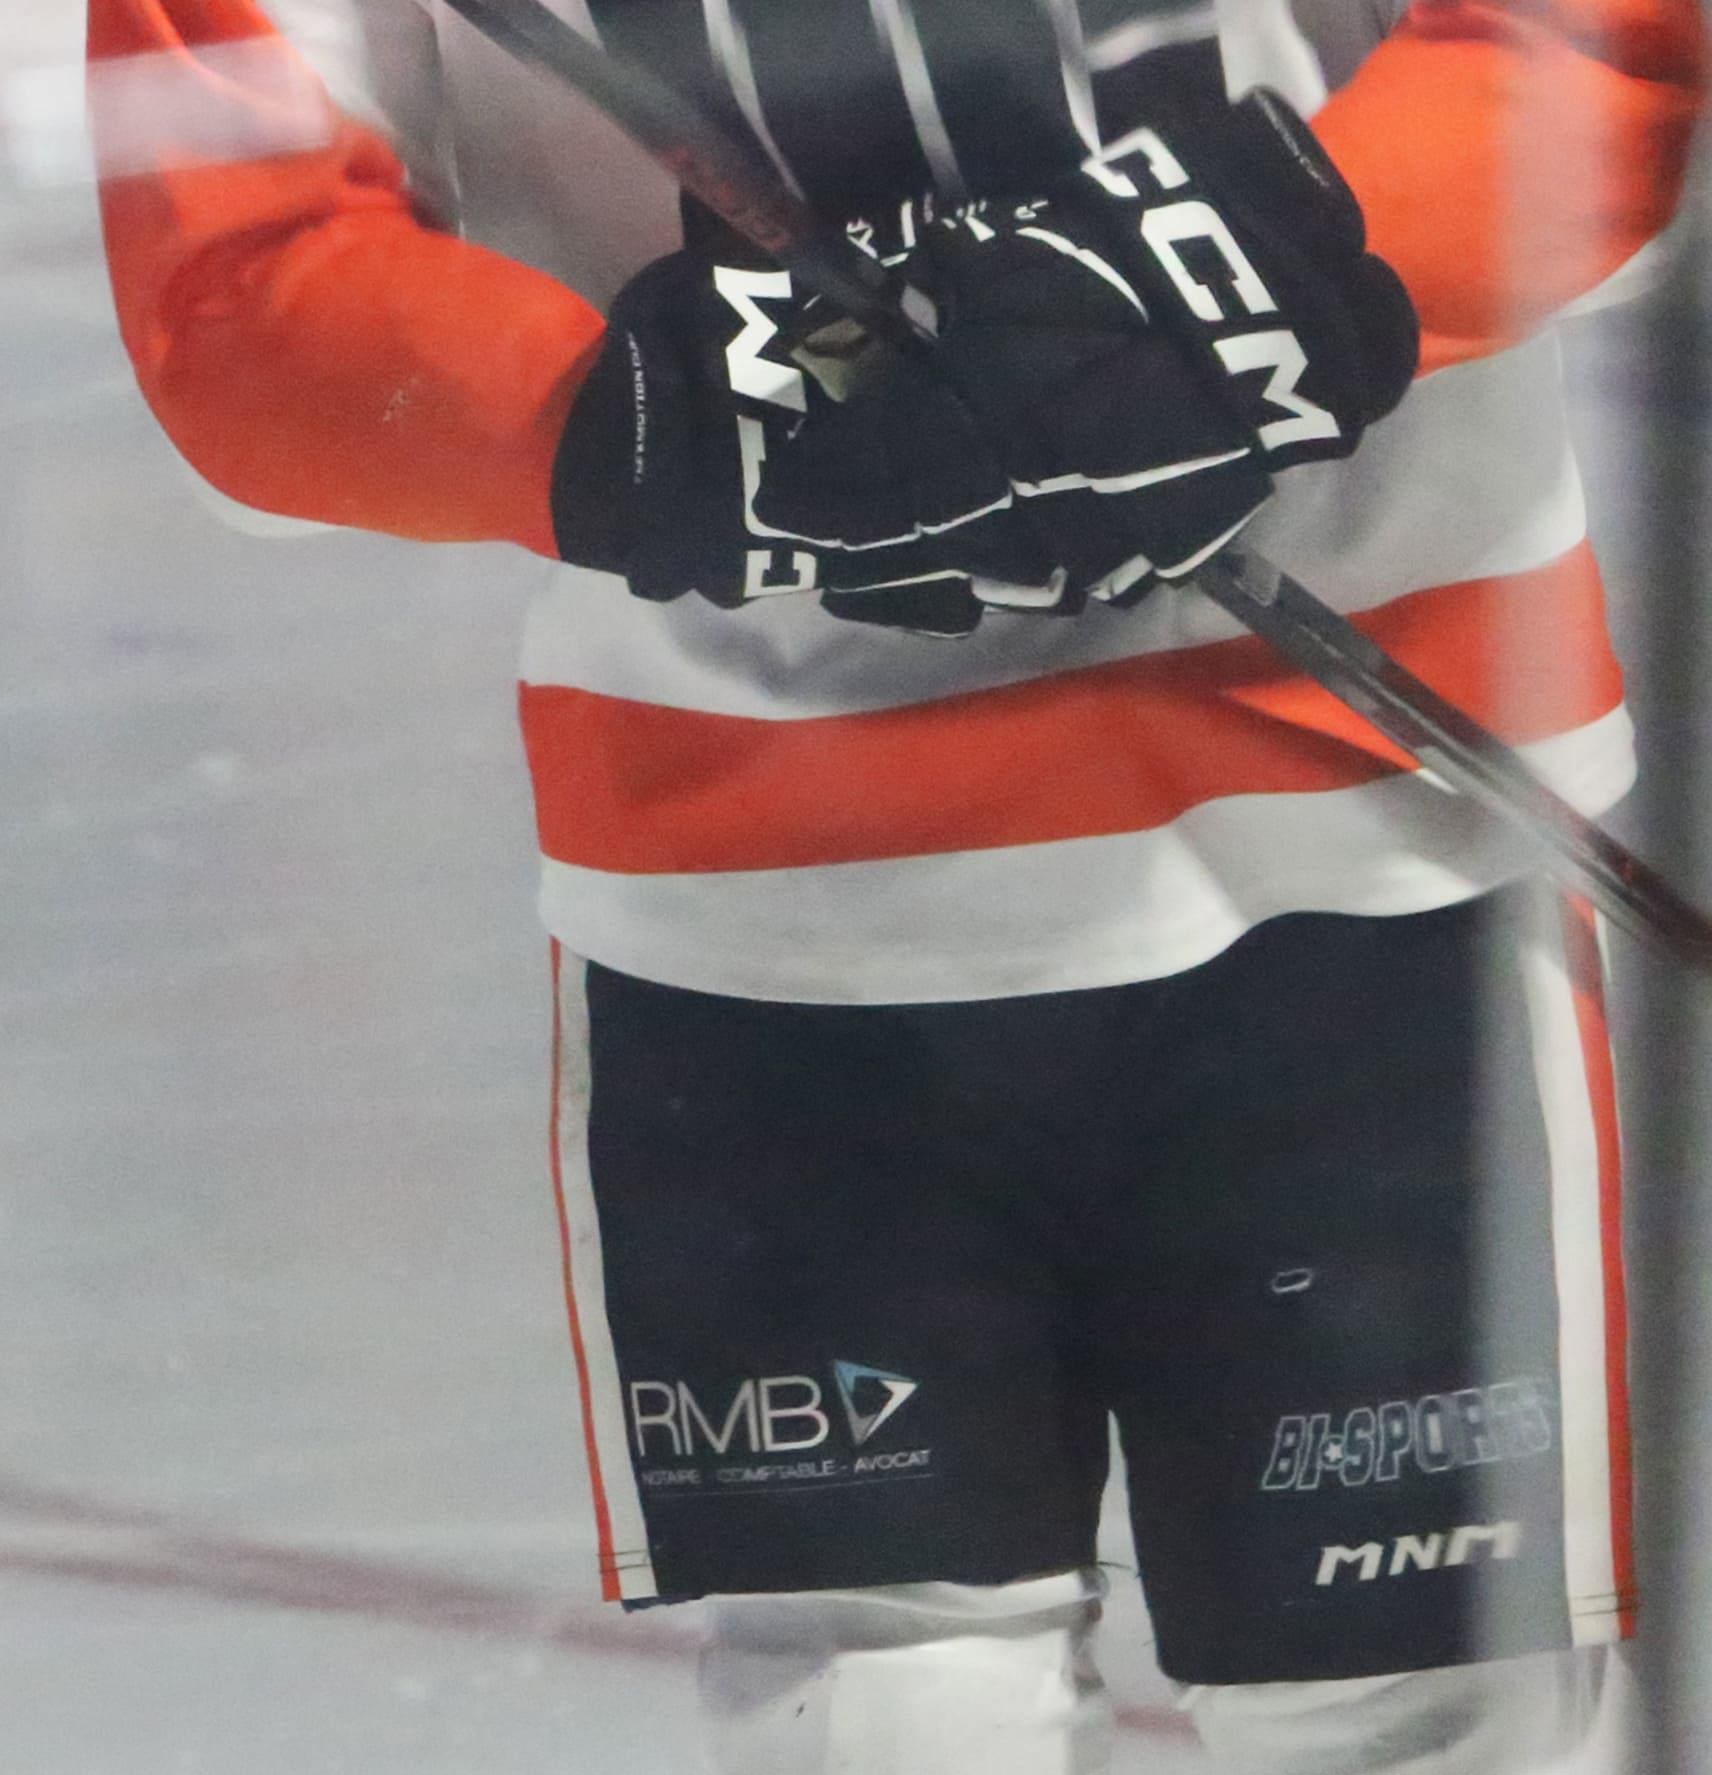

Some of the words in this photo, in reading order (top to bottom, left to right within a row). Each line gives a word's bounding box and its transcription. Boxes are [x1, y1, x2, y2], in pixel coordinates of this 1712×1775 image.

[1081, 126, 1341, 451] CCM
[629, 1375, 830, 1457] RMB
[853, 1449, 932, 1472] AVOCAT
[1315, 1521, 1523, 1586] MNM
